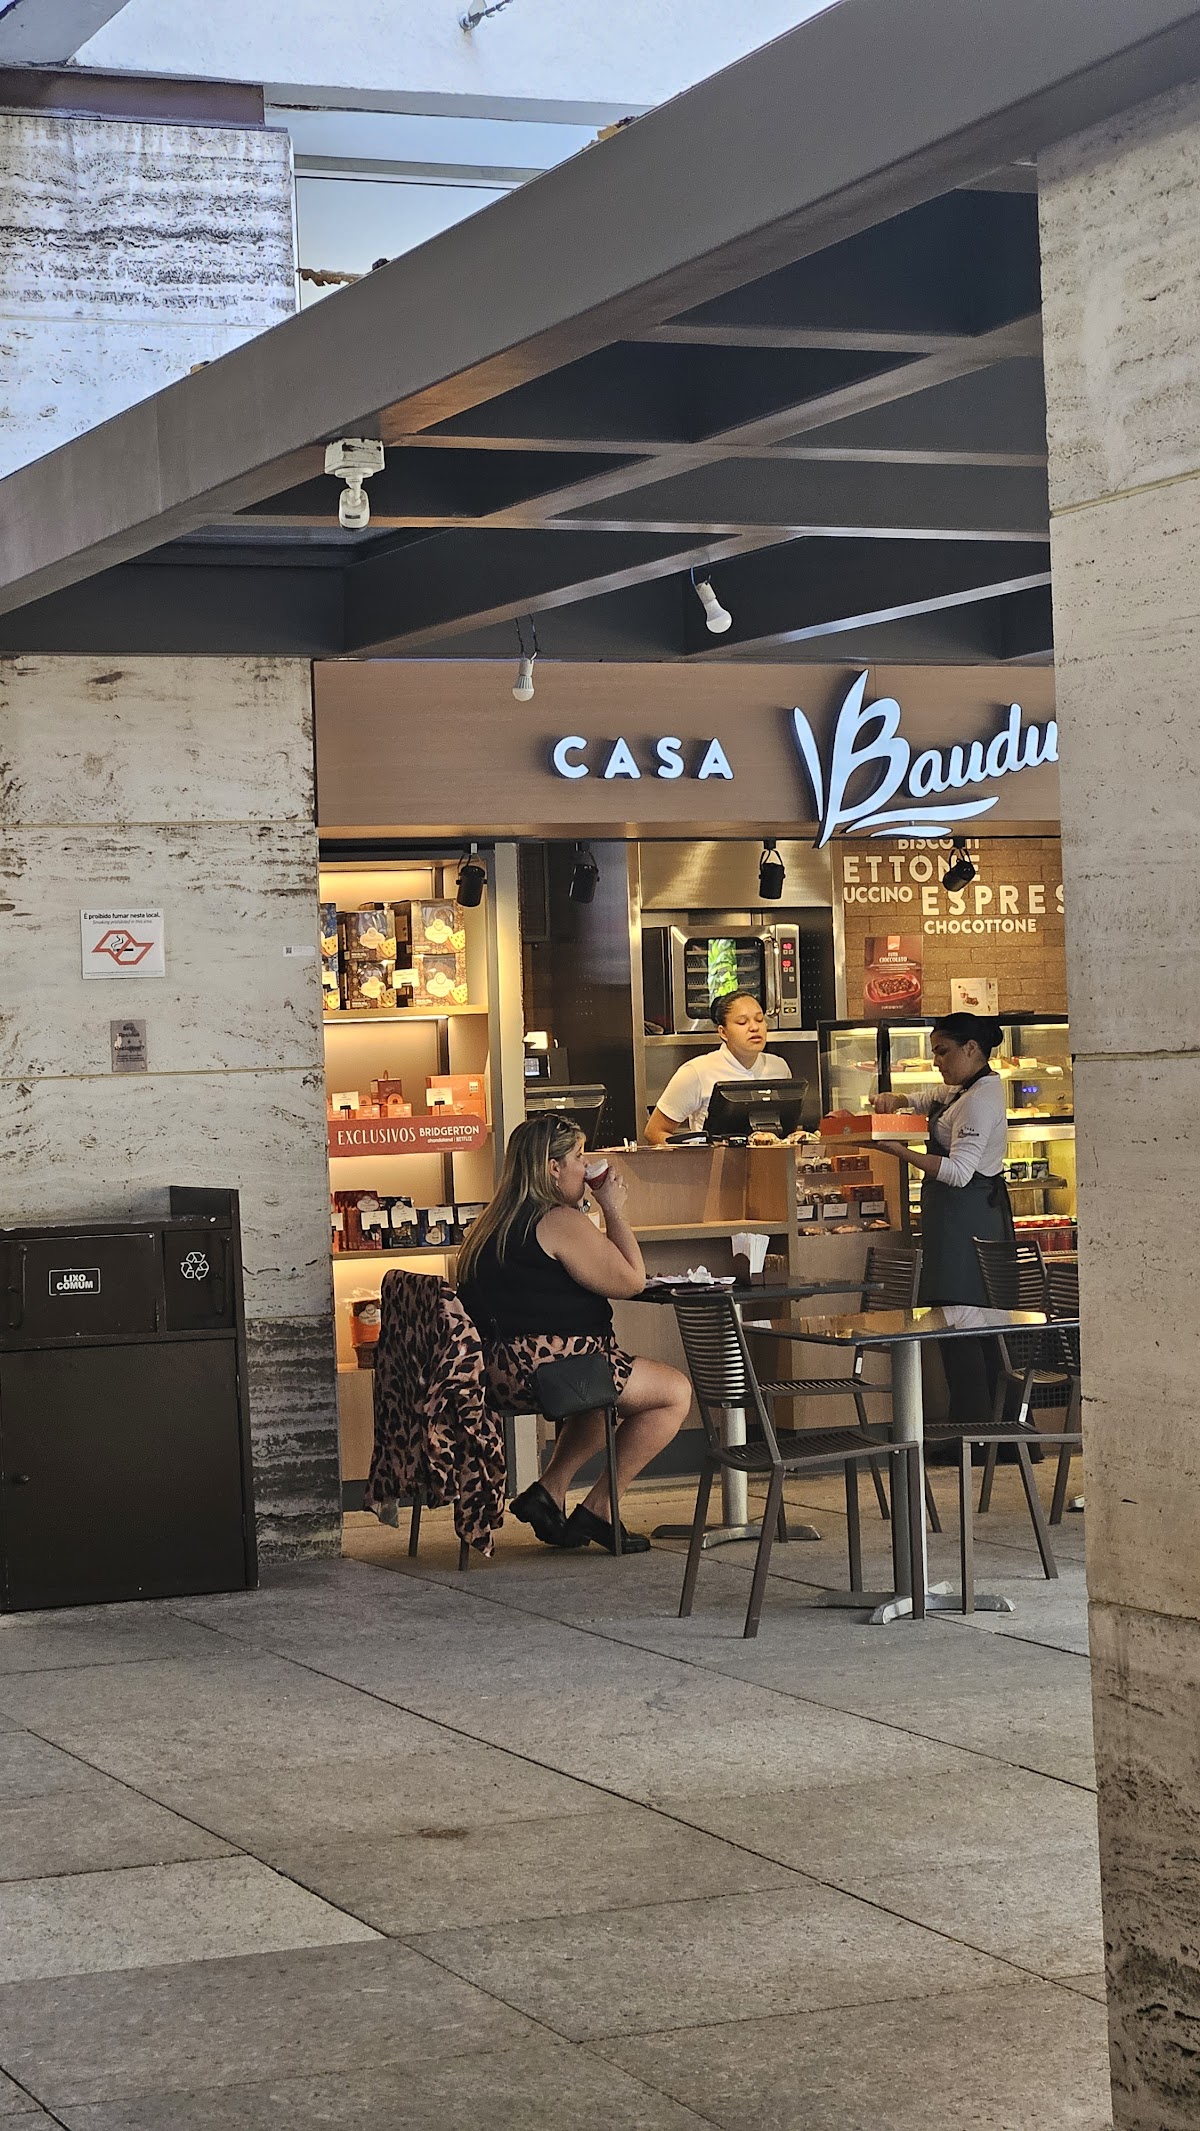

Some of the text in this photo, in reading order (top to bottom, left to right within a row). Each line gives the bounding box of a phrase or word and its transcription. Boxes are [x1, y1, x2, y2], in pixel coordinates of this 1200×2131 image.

[552, 735, 734, 780] CASA
[898, 839, 980, 850] BISCOTI
[843, 886, 913, 904] UCCINO
[88, 912, 112, 920] proibido
[924, 918, 1037, 935] CHOCOTTONE
[337, 1127, 416, 1146] EXCLUSIVOS
[419, 1125, 479, 1137] BRIDGERTON
[63, 1273, 86, 1283] LIXO
[56, 1280, 94, 1291] COMUM
